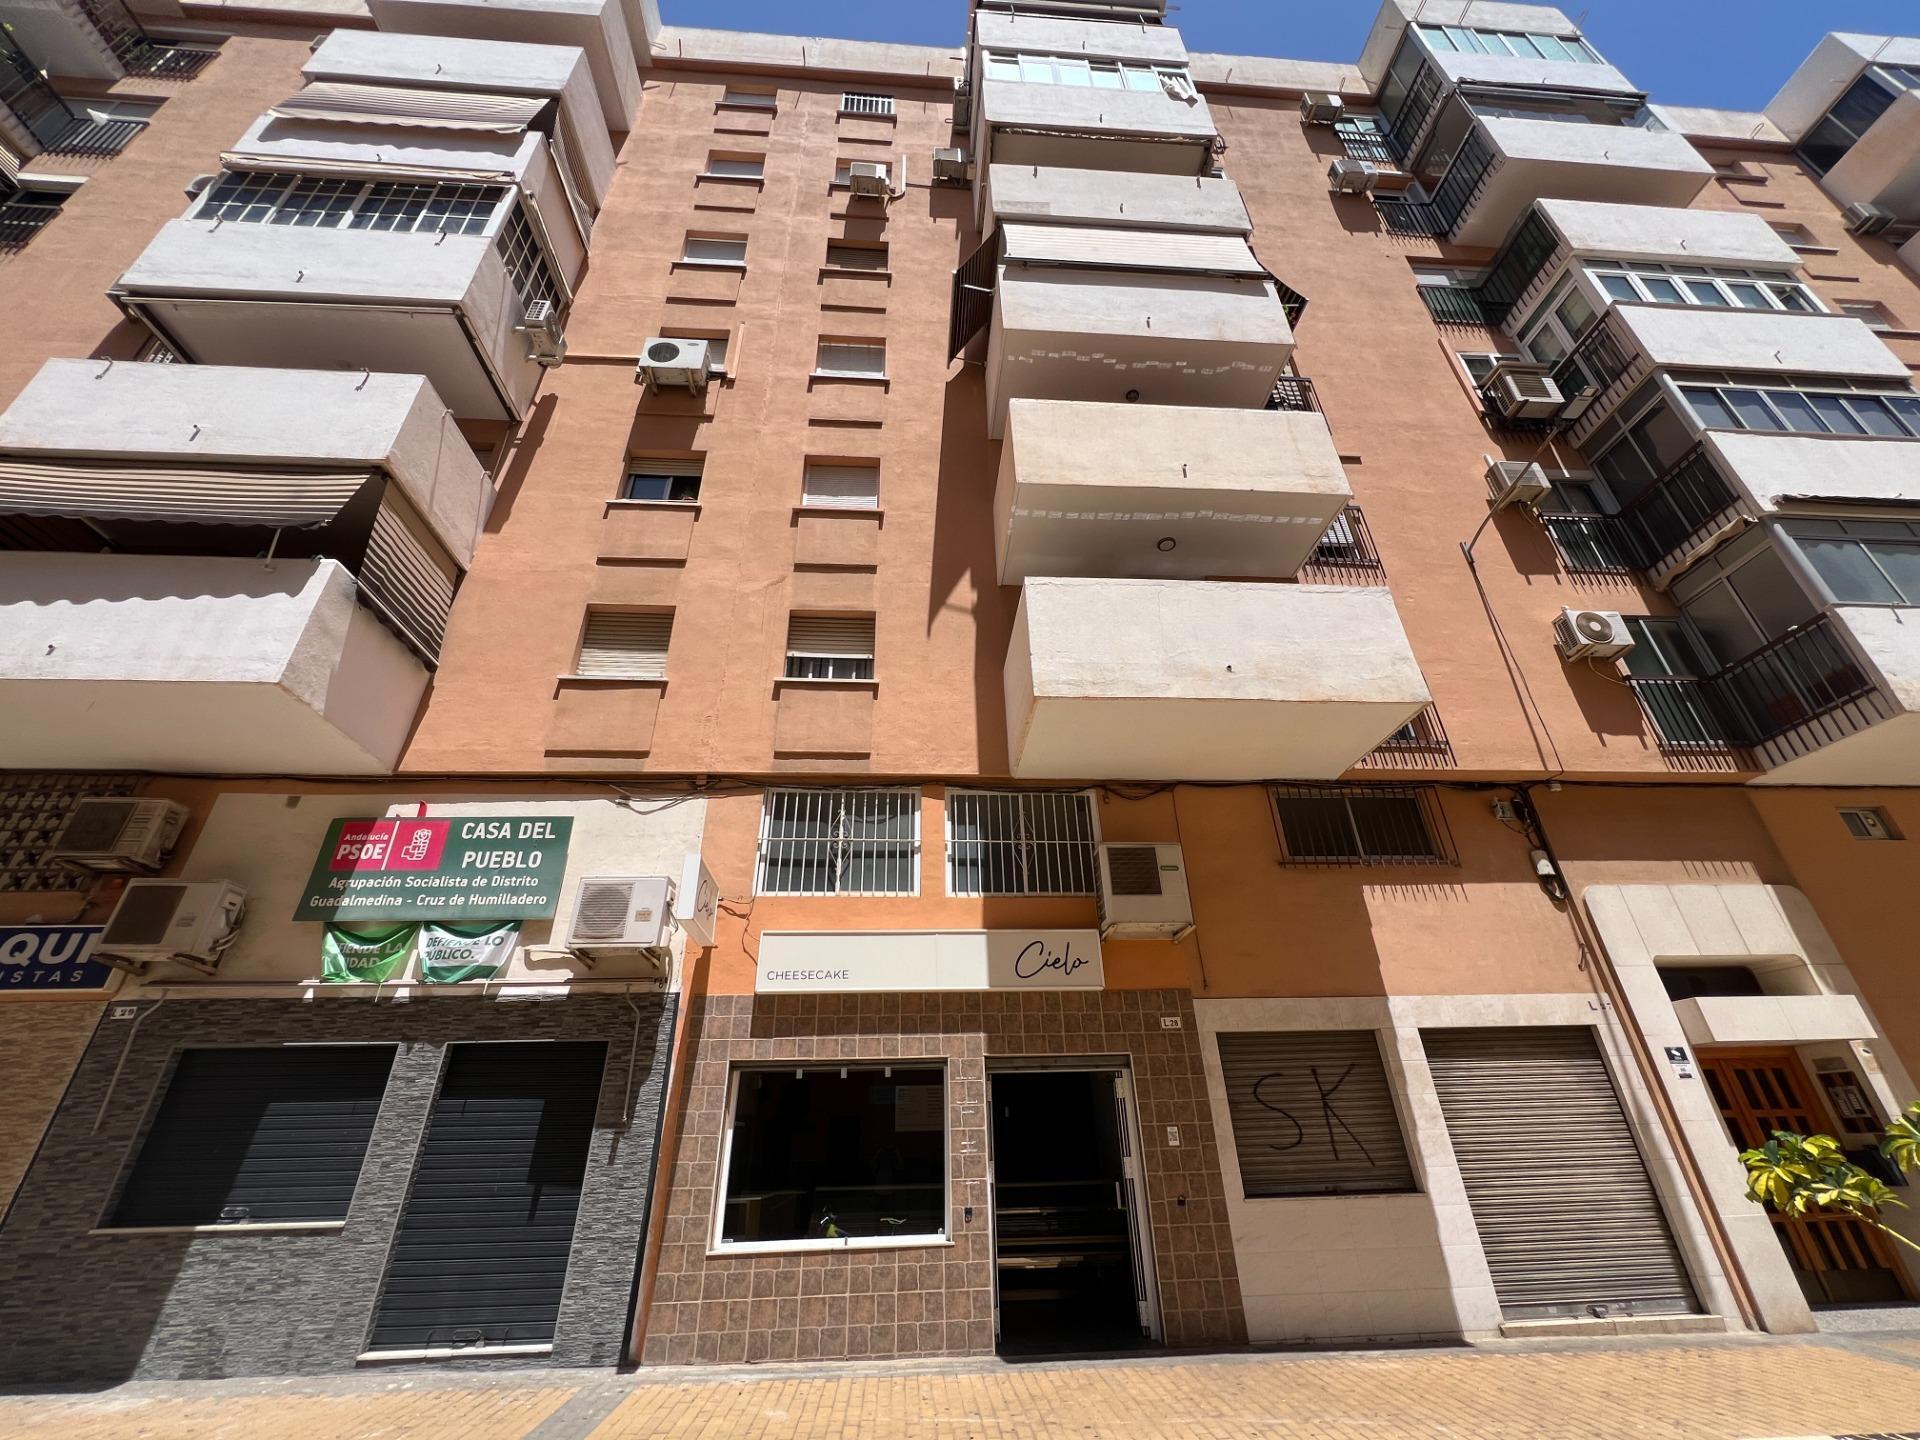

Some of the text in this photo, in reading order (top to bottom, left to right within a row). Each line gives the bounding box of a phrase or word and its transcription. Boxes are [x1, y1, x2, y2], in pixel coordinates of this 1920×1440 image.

[343, 832, 390, 841] Andalucía
[461, 822, 556, 839] CASA DEL
[336, 843, 387, 860] PSOE
[461, 850, 543, 869] PUEBLO
[328, 875, 539, 891] Agrupación Socialista de Distrito
[310, 894, 403, 907] Guadalmedina
[416, 894, 445, 906] Cruz
[449, 894, 465, 906] de
[468, 893, 548, 905] Humilladero
[385, 942, 404, 954] LA
[484, 935, 505, 947] LO
[1014, 940, 1089, 978] Cielo
[766, 969, 849, 981] CHEESECAKE
[1253, 1063, 1376, 1168] SK
